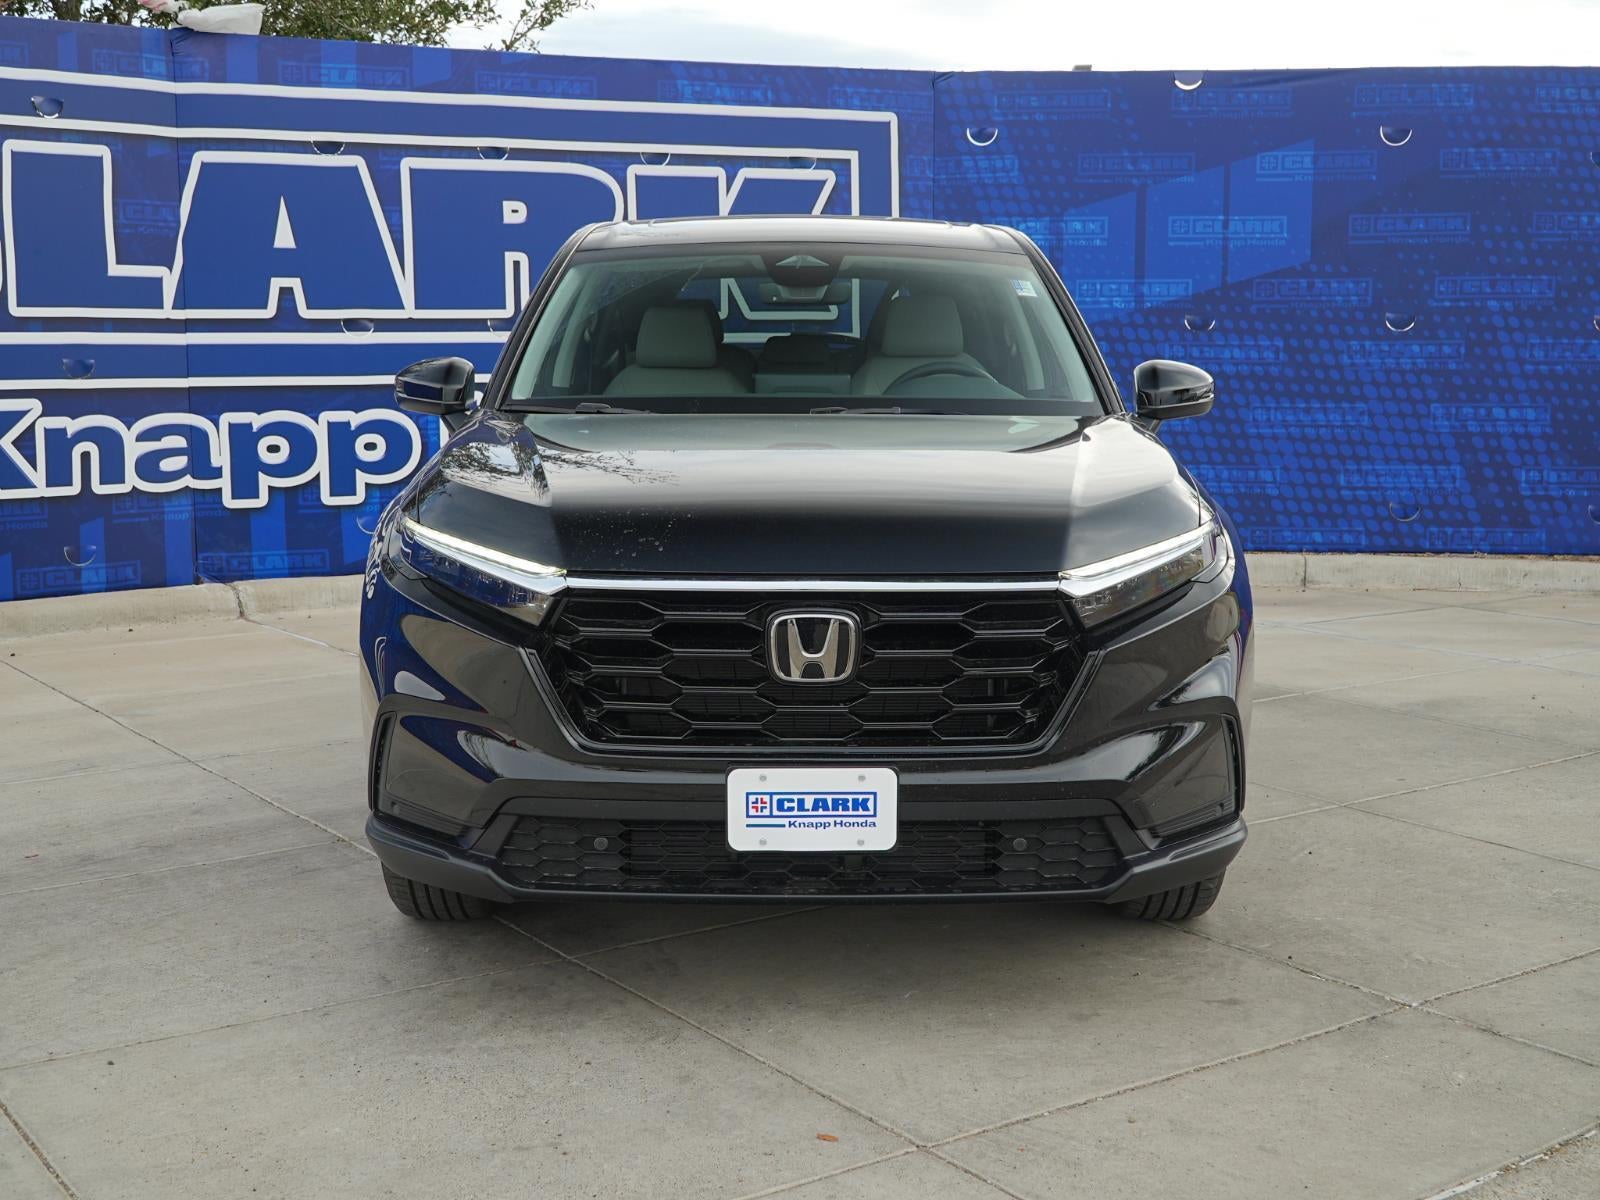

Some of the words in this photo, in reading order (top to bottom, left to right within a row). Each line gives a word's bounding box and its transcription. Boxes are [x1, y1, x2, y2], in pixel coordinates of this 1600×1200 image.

[776, 797, 871, 812] CLARK
[788, 819, 831, 830] Knapp
[833, 819, 877, 828] Honda
